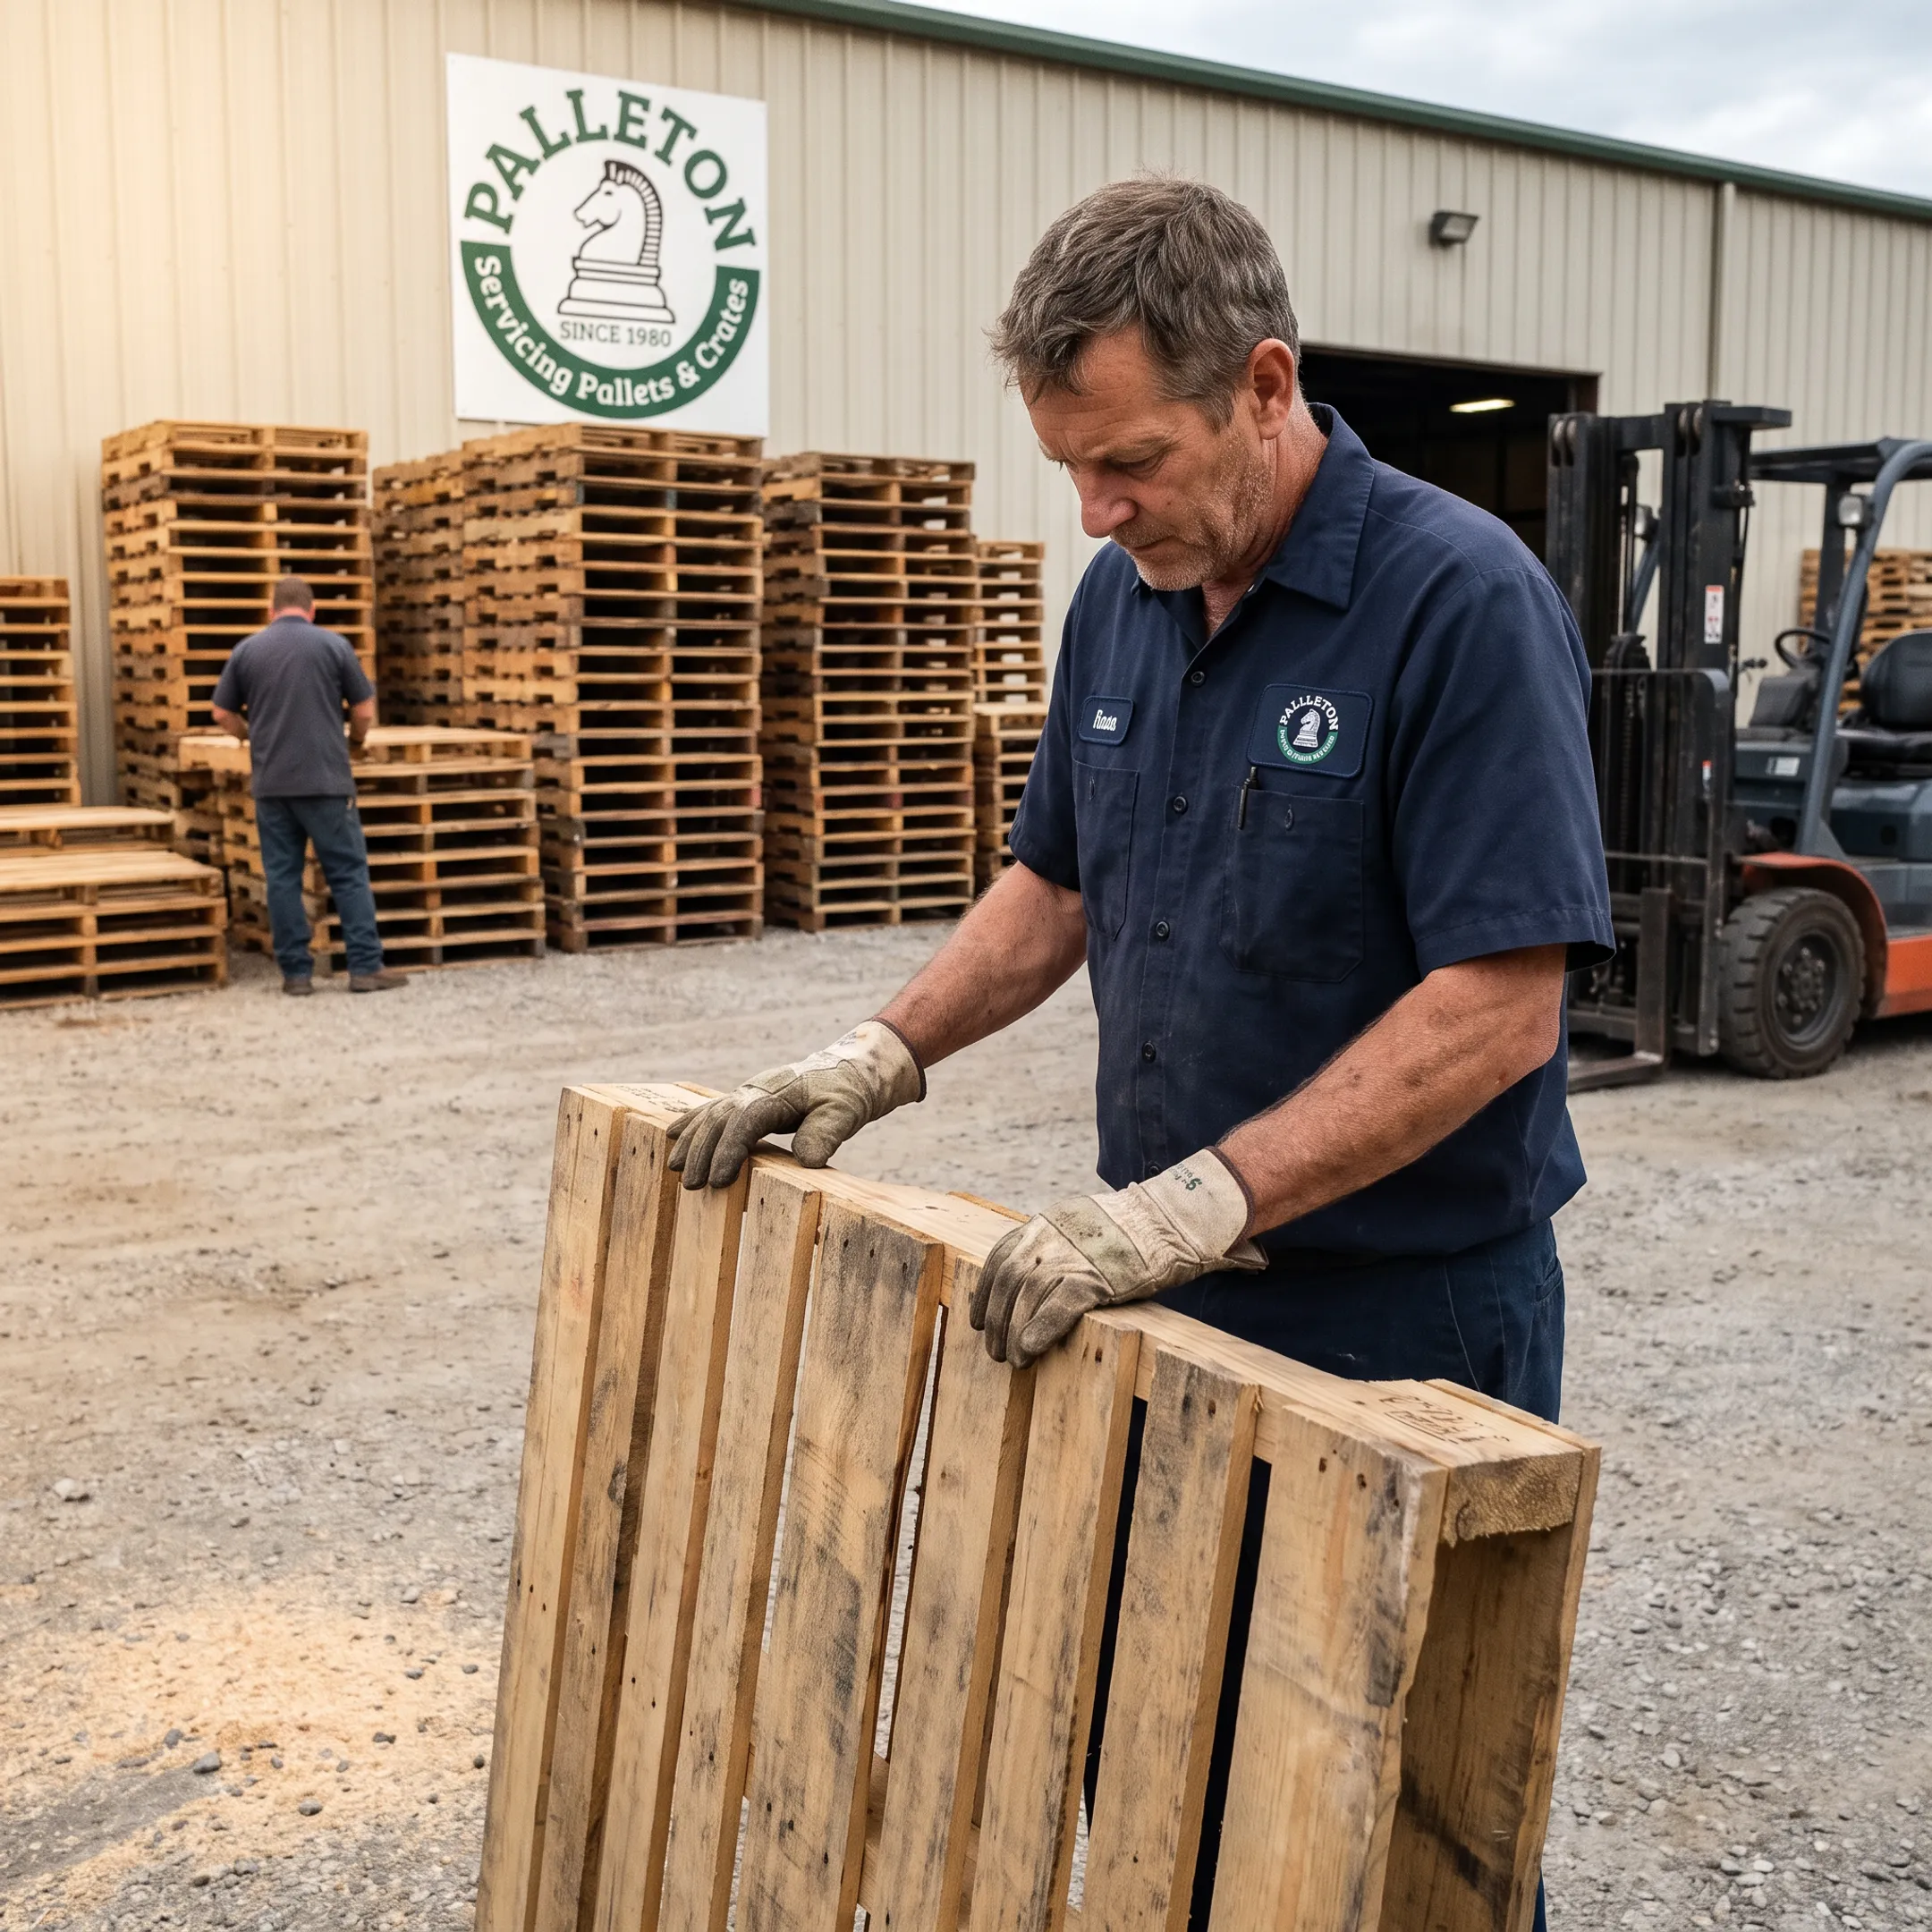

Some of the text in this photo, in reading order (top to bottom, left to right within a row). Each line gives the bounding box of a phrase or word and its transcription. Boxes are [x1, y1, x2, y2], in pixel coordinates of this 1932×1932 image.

[463, 88, 757, 252] PALLETON
[474, 255, 750, 407] Servicing Pallets & Crates
[560, 321, 672, 348] SINCE 1980
